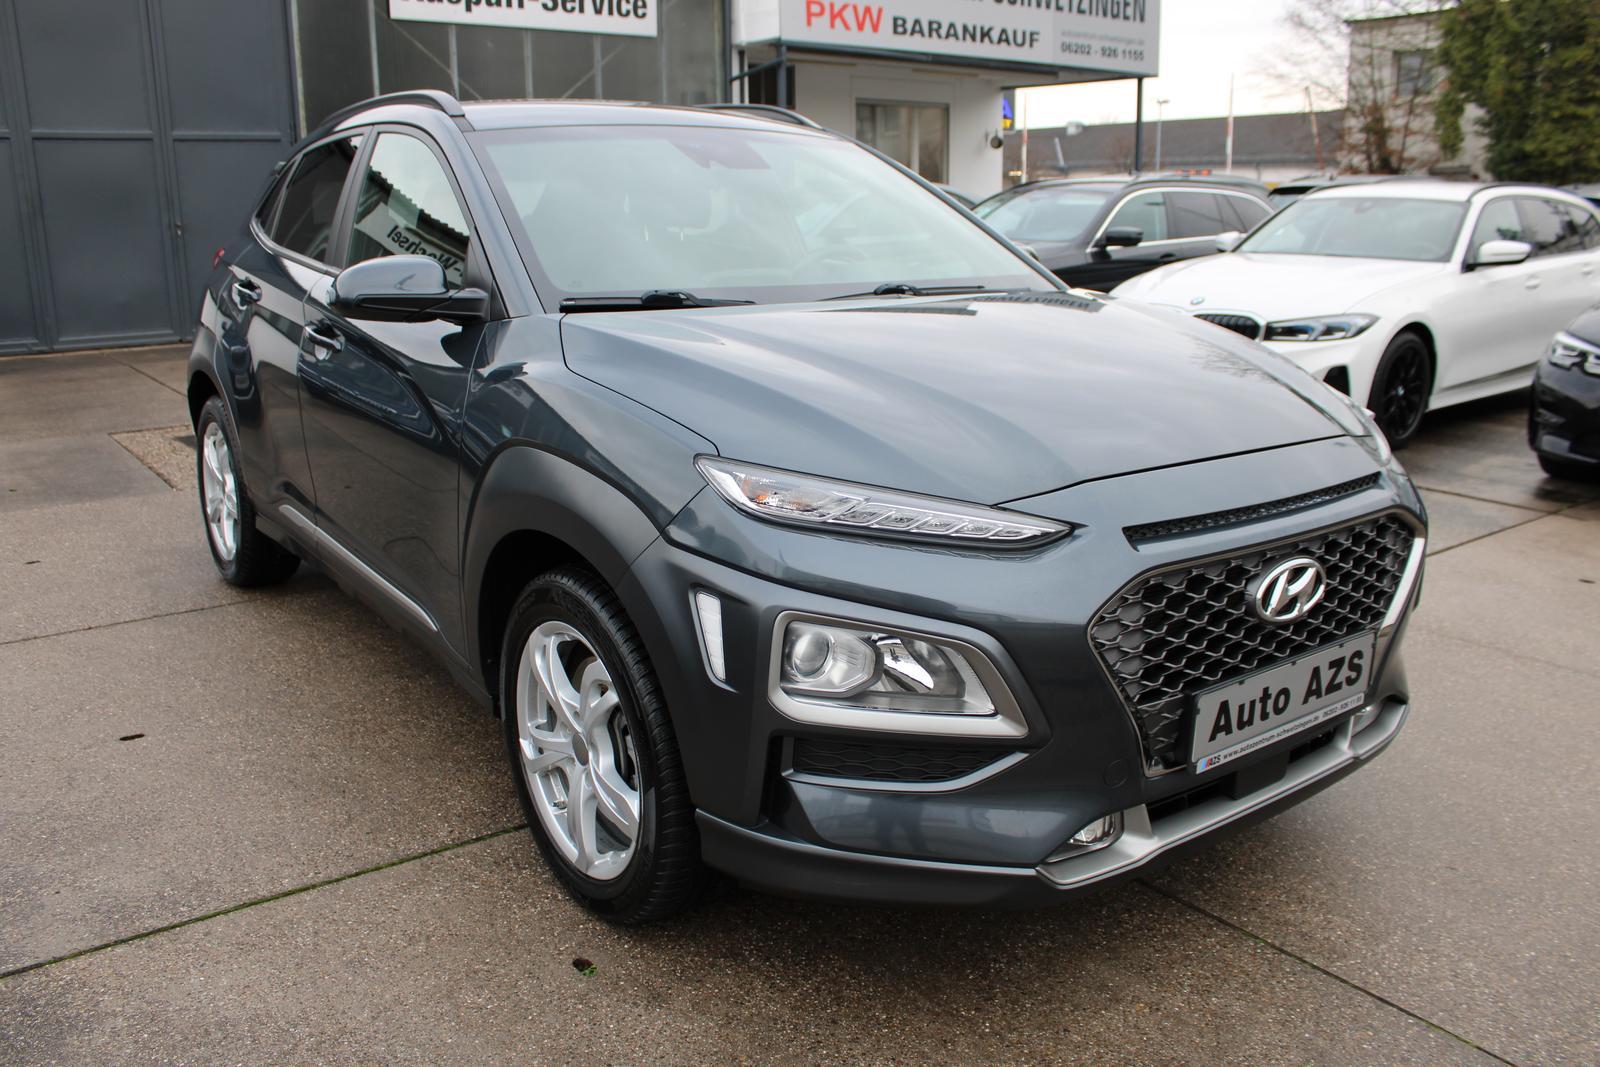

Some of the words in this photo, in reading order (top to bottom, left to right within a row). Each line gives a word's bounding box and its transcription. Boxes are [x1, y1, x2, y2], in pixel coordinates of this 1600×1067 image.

[804, 0, 884, 34] PKW
[892, 15, 1041, 49] BARANKAUF
[1208, 685, 1291, 743] Auto
[1301, 649, 1364, 706] AZS
